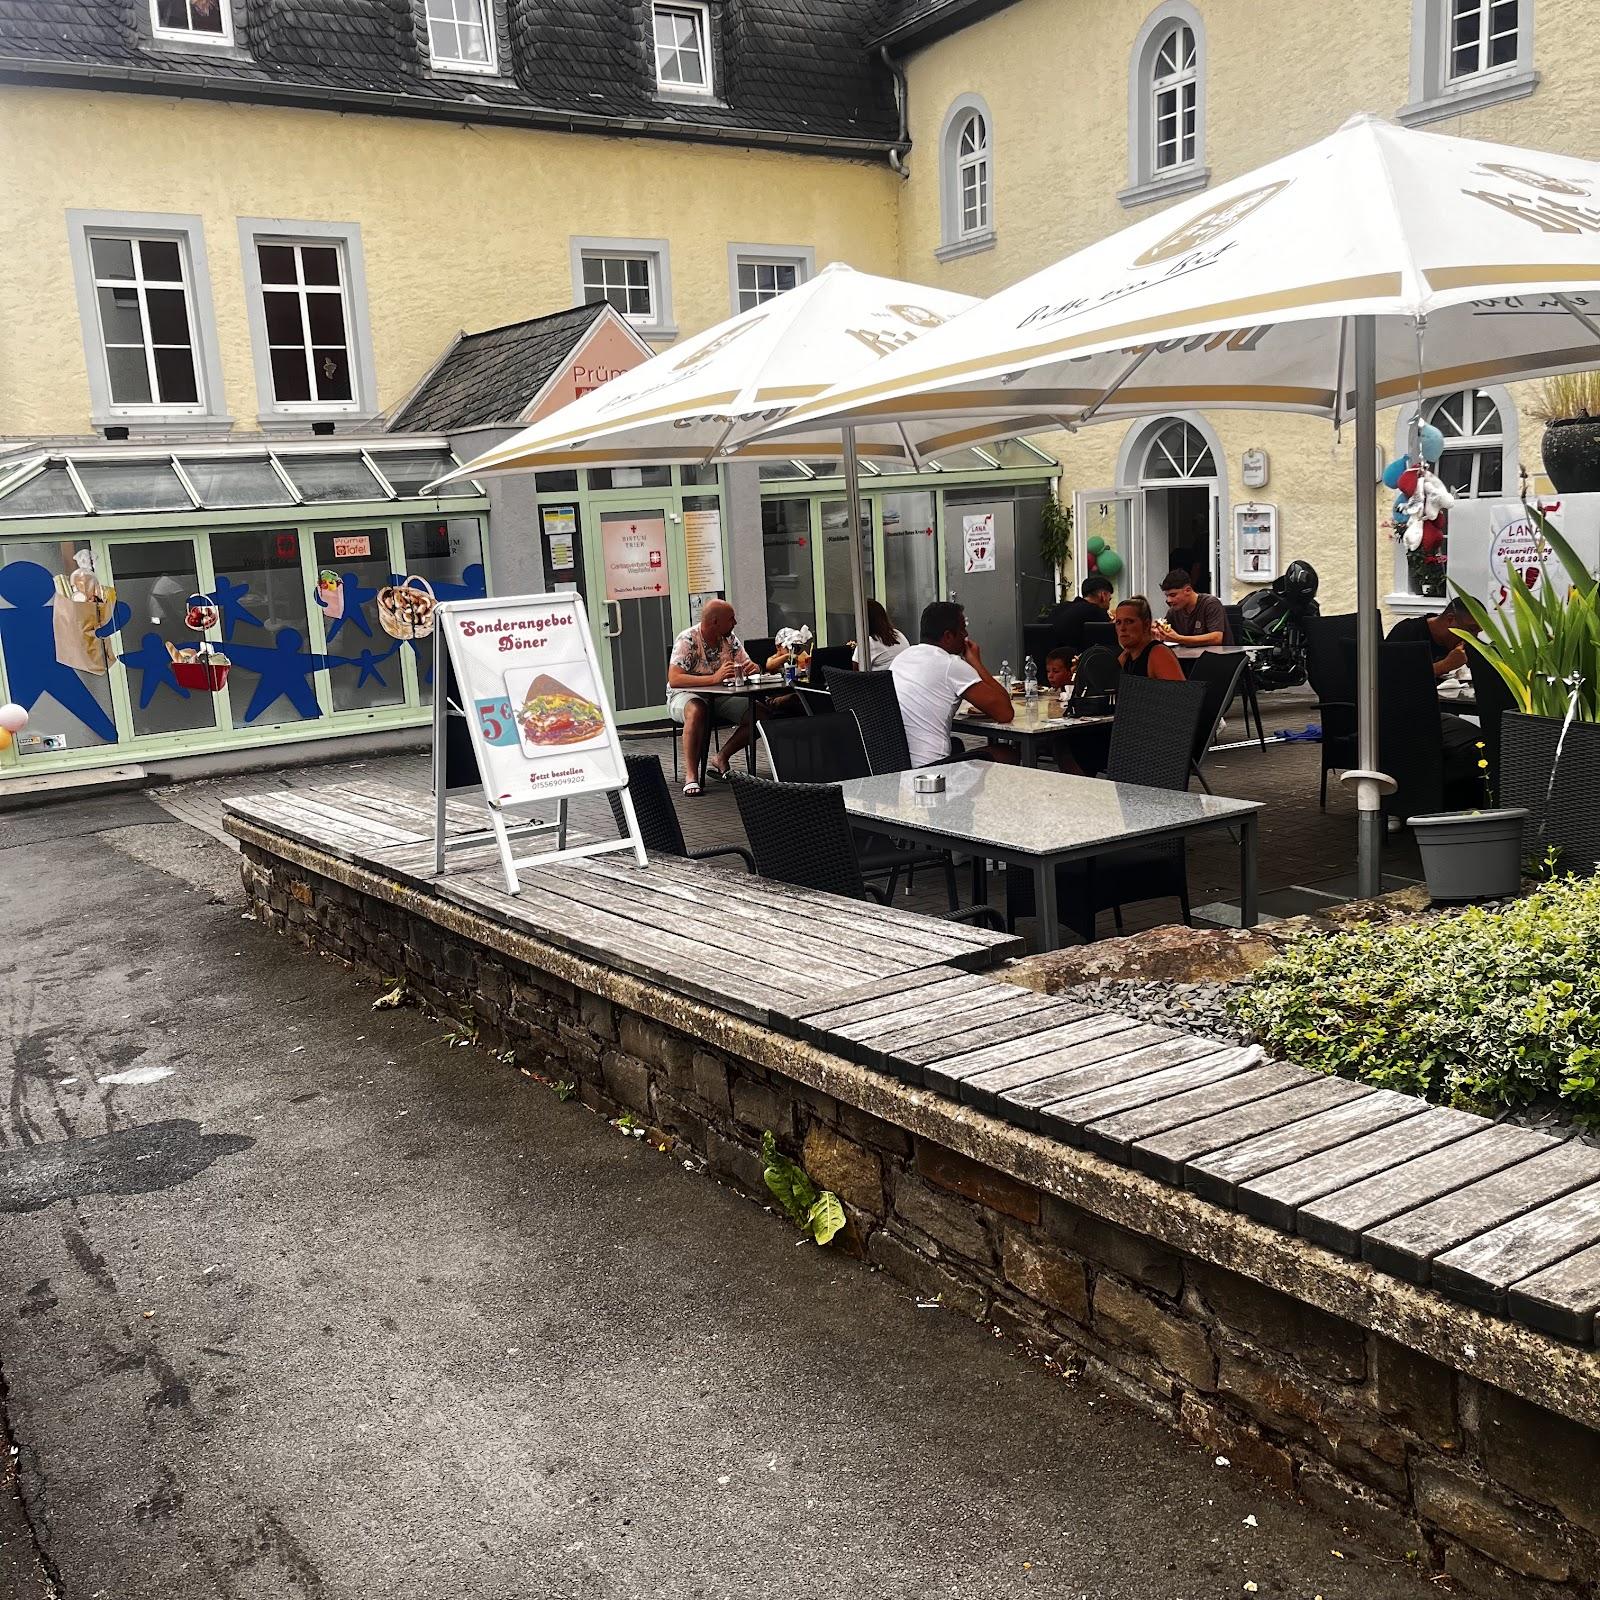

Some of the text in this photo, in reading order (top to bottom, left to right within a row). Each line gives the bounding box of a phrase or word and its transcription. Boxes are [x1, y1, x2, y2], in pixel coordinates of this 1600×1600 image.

[346, 545, 367, 555] Tafel
[460, 614, 573, 637] Sonderangebot
[498, 634, 548, 652] Döner
[529, 767, 584, 783] Jetzt bestellen
